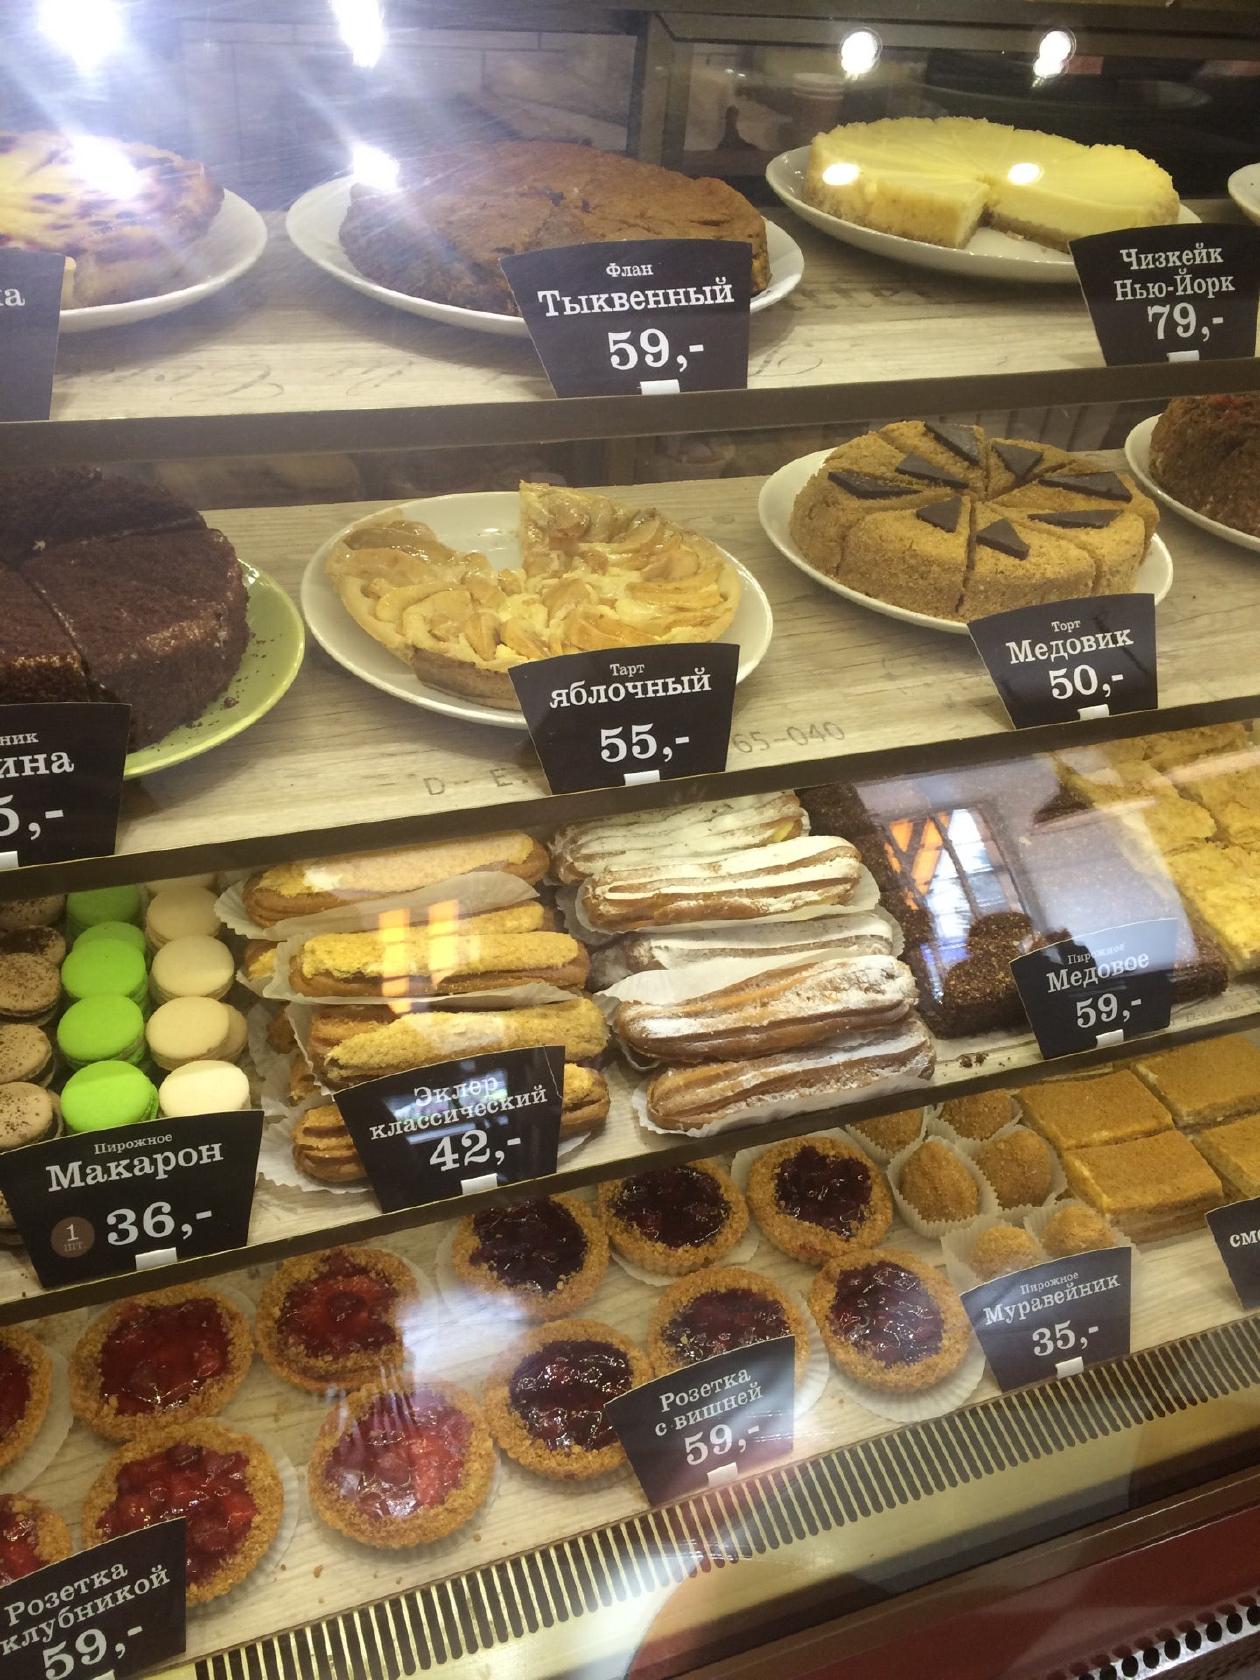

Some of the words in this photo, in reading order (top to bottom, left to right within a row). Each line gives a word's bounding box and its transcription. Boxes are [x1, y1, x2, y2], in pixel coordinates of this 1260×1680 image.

[606, 262, 654, 278] Флан
[1120, 242, 1224, 271] Чизкейк
[537, 276, 735, 317] Тыквенный
[1113, 267, 1236, 301] Нью-Йорк
[1147, 302, 1224, 342] 79,-
[607, 328, 704, 372] 59,-
[1051, 620, 1081, 633] Торт
[1005, 629, 1134, 665] Медовик
[549, 667, 712, 709] яблочный
[609, 663, 645, 678] Тарт
[1048, 664, 1124, 700] 50,-
[600, 723, 690, 763] 55,-
[1046, 952, 1150, 993] Медовое
[1067, 943, 1125, 965] Пирожное
[1075, 993, 1142, 1029] 59,-
[413, 1076, 499, 1107] Эклер
[369, 1084, 548, 1141] классический
[94, 1133, 173, 1155] Пирожное
[429, 1129, 521, 1172] 42,-
[45, 1142, 225, 1193] Макарон
[66, 1223, 79, 1242] 1
[106, 1201, 213, 1246] 36,-
[1229, 1229, 1260, 1248] см
[983, 1274, 1121, 1326] Муравейник
[1020, 1271, 1080, 1295] Пирожное
[1032, 1320, 1099, 1357] 35,-
[655, 1422, 668, 1437] с
[674, 1381, 763, 1430] вишней
[659, 1369, 752, 1413] Розетка
[684, 1423, 760, 1466] 59,-
[0, 1564, 171, 1656] клубникой
[4, 1563, 128, 1627] Розетка
[42, 1625, 143, 1680] 59,-
